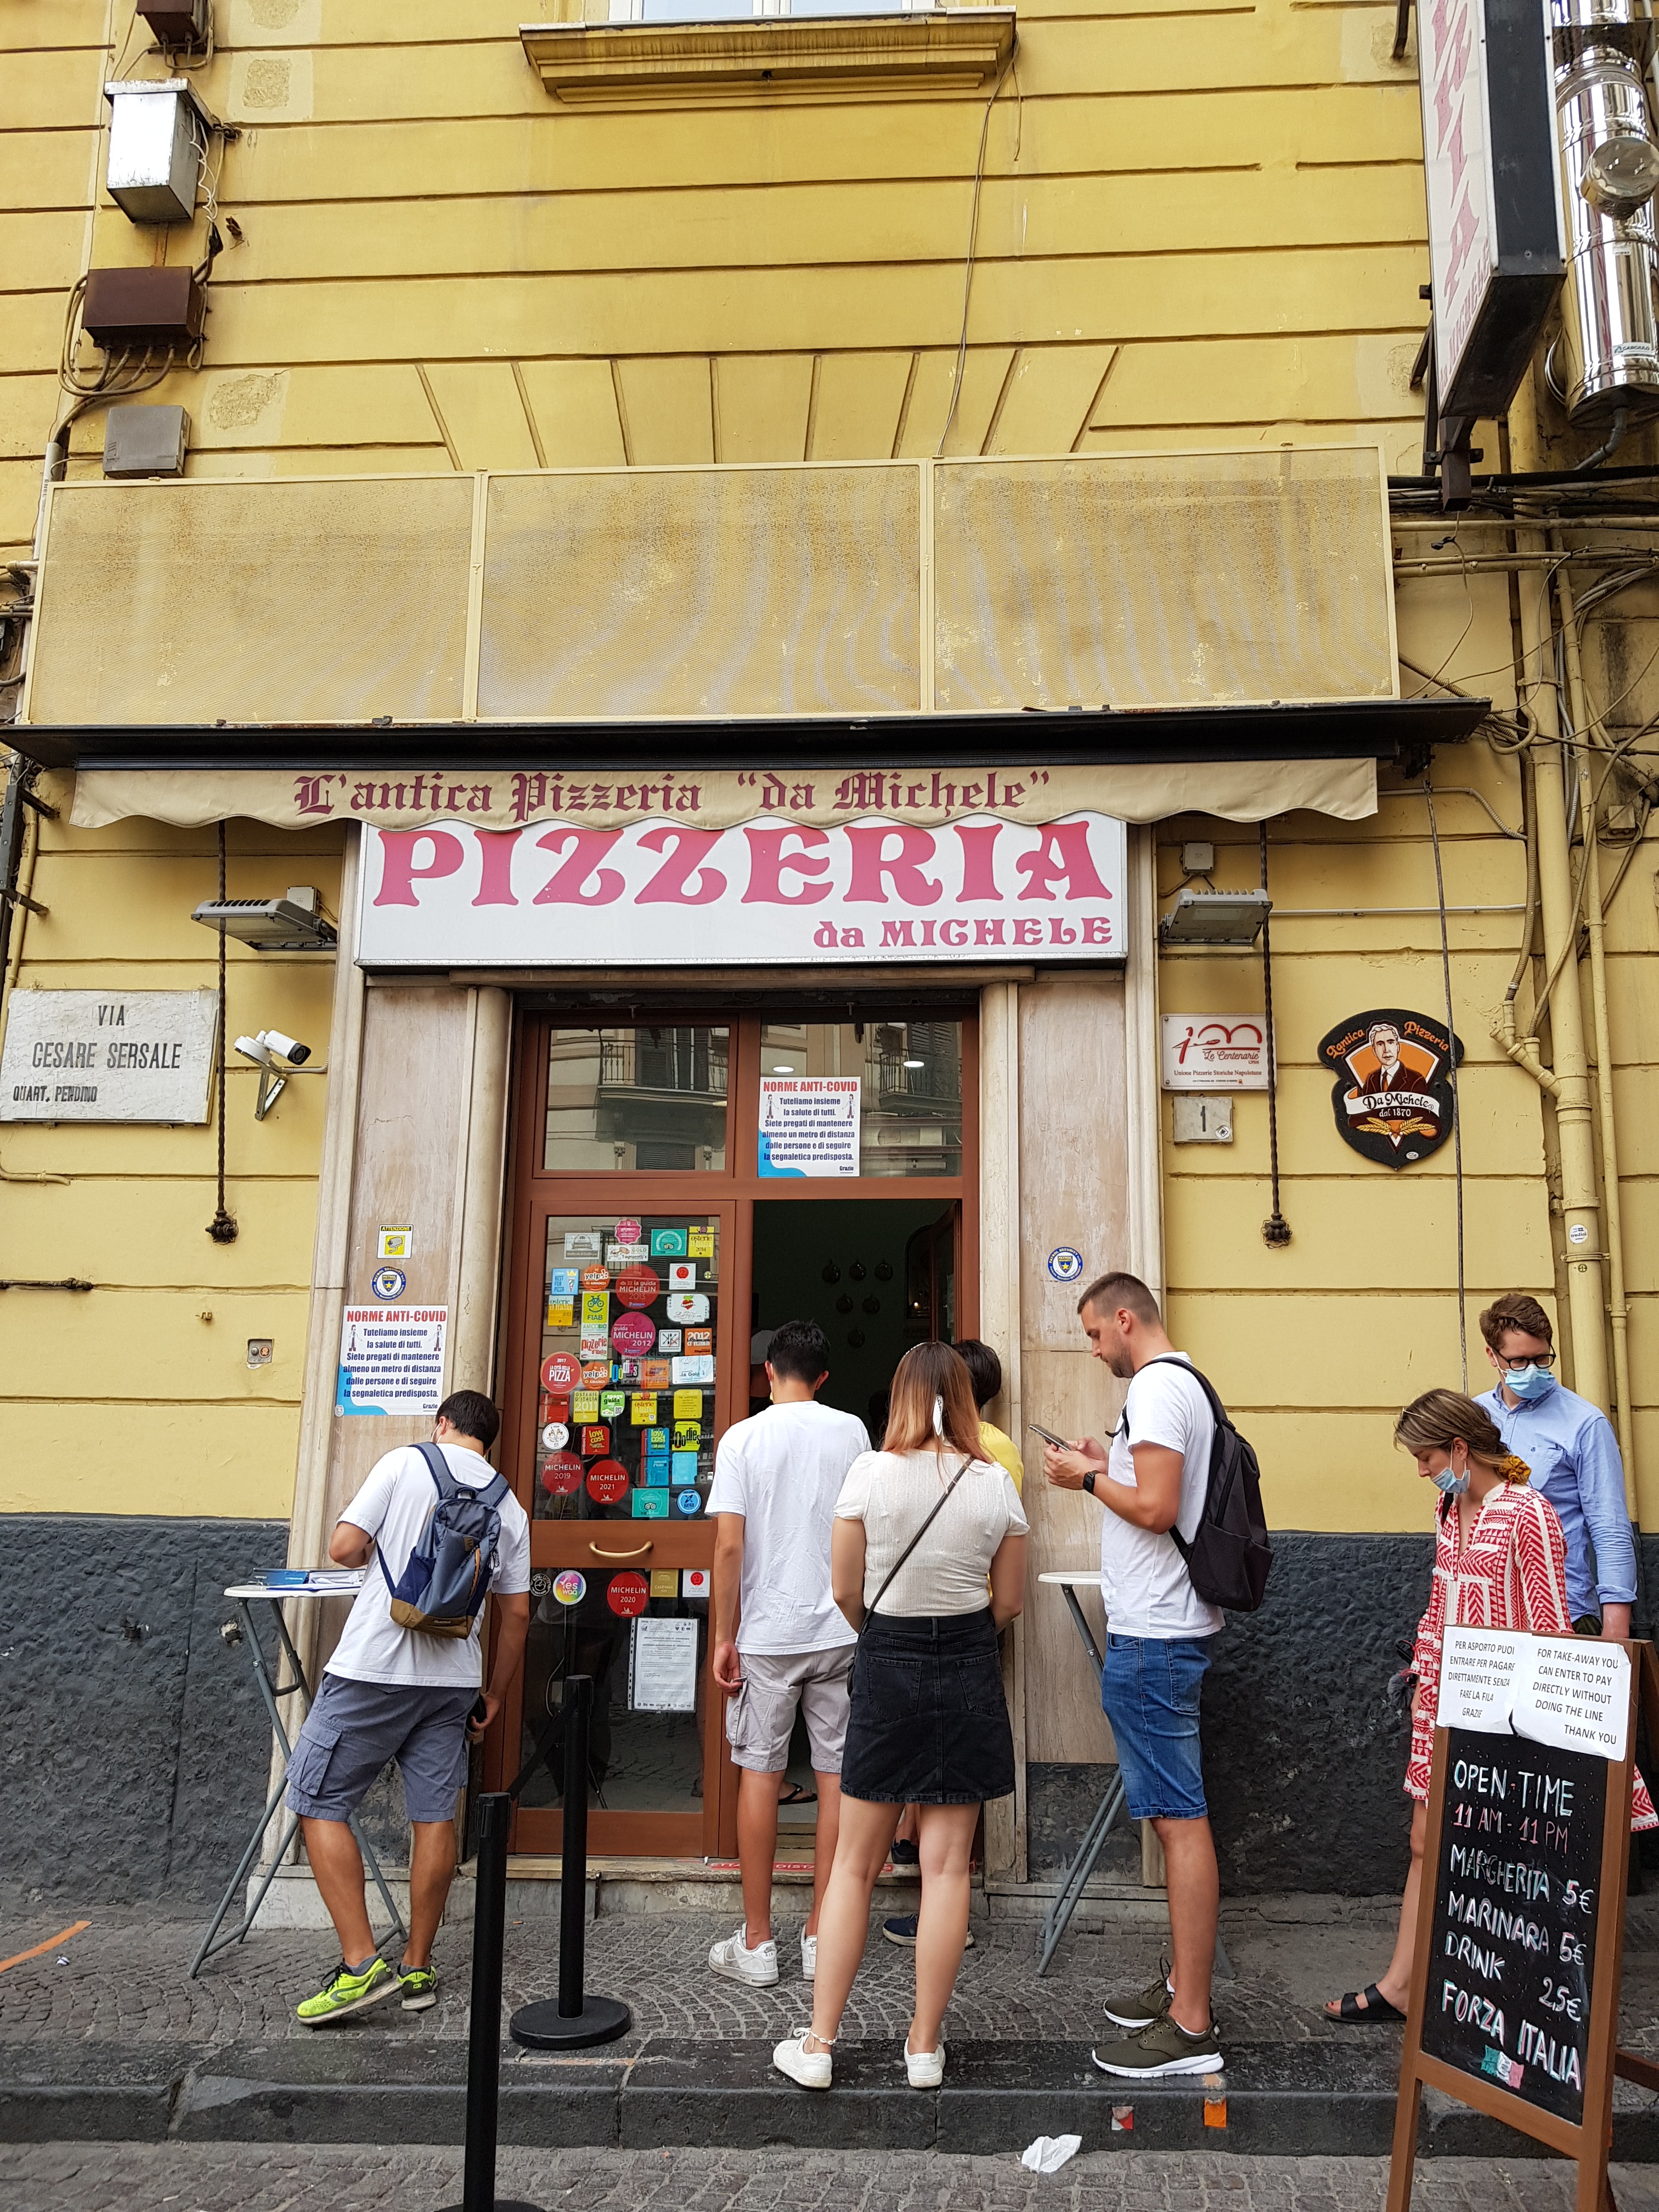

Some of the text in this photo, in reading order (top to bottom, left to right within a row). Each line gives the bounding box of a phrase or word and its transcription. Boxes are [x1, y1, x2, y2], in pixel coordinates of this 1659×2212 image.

[294, 774, 493, 816] L'antica
[511, 772, 702, 822] Pizzeria
[373, 821, 1113, 906] PIZZERIA
[814, 917, 1113, 947] da MICHELE
[98, 1005, 125, 1026] VIA
[1404, 1021, 1449, 1052] Pizzeria
[32, 1042, 183, 1069] CESARE SERSALE
[13, 1086, 98, 1102] QUART. PENDINO
[764, 1081, 857, 1092] NORME ANTI-COVID
[1363, 1092, 1429, 1110] Da Michele
[1200, 1106, 1206, 1132] 1
[1379, 1108, 1412, 1118] dal 1870
[347, 1311, 446, 1322] NORME ANTI-COVID
[366, 1353, 392, 1362] pregati
[410, 1377, 436, 1386] seguire
[549, 1370, 571, 1381] PIZZA
[352, 1390, 393, 1398] segnaletica
[395, 1390, 438, 1398] predisposta.
[575, 1402, 597, 1412] 2011
[589, 1429, 603, 1438] low
[590, 1435, 605, 1443] cost
[1455, 1640, 1515, 1655] PER ASPORTO PUOI
[1450, 1656, 1515, 1671] ENTRARE PER PAGARE
[1537, 1649, 1618, 1669] FOR TAKE-AWAY YOU
[1448, 1672, 1509, 1686] DIRETTAMENTE SENZA
[1538, 1666, 1612, 1686] CAN ENTER TO PAY
[1460, 1690, 1493, 1702] FARE LA FILA
[1533, 1682, 1612, 1705] DIRECTLY WITHOUT
[1462, 1708, 1482, 1718] GRAZIE
[1536, 1699, 1603, 1722] DOING THE LINE
[1565, 1725, 1617, 1745] THANK YOU
[1454, 1760, 1575, 1818] OPEN TIME
[1454, 1803, 1568, 1854] 11 AM 11 PM
[1451, 1844, 1550, 1903] MARGHERITA
[1448, 1891, 1549, 1954] MARINARA
[1446, 1931, 1505, 1980] DRINK
[1442, 1980, 1581, 2092] FORZA ITALIA
